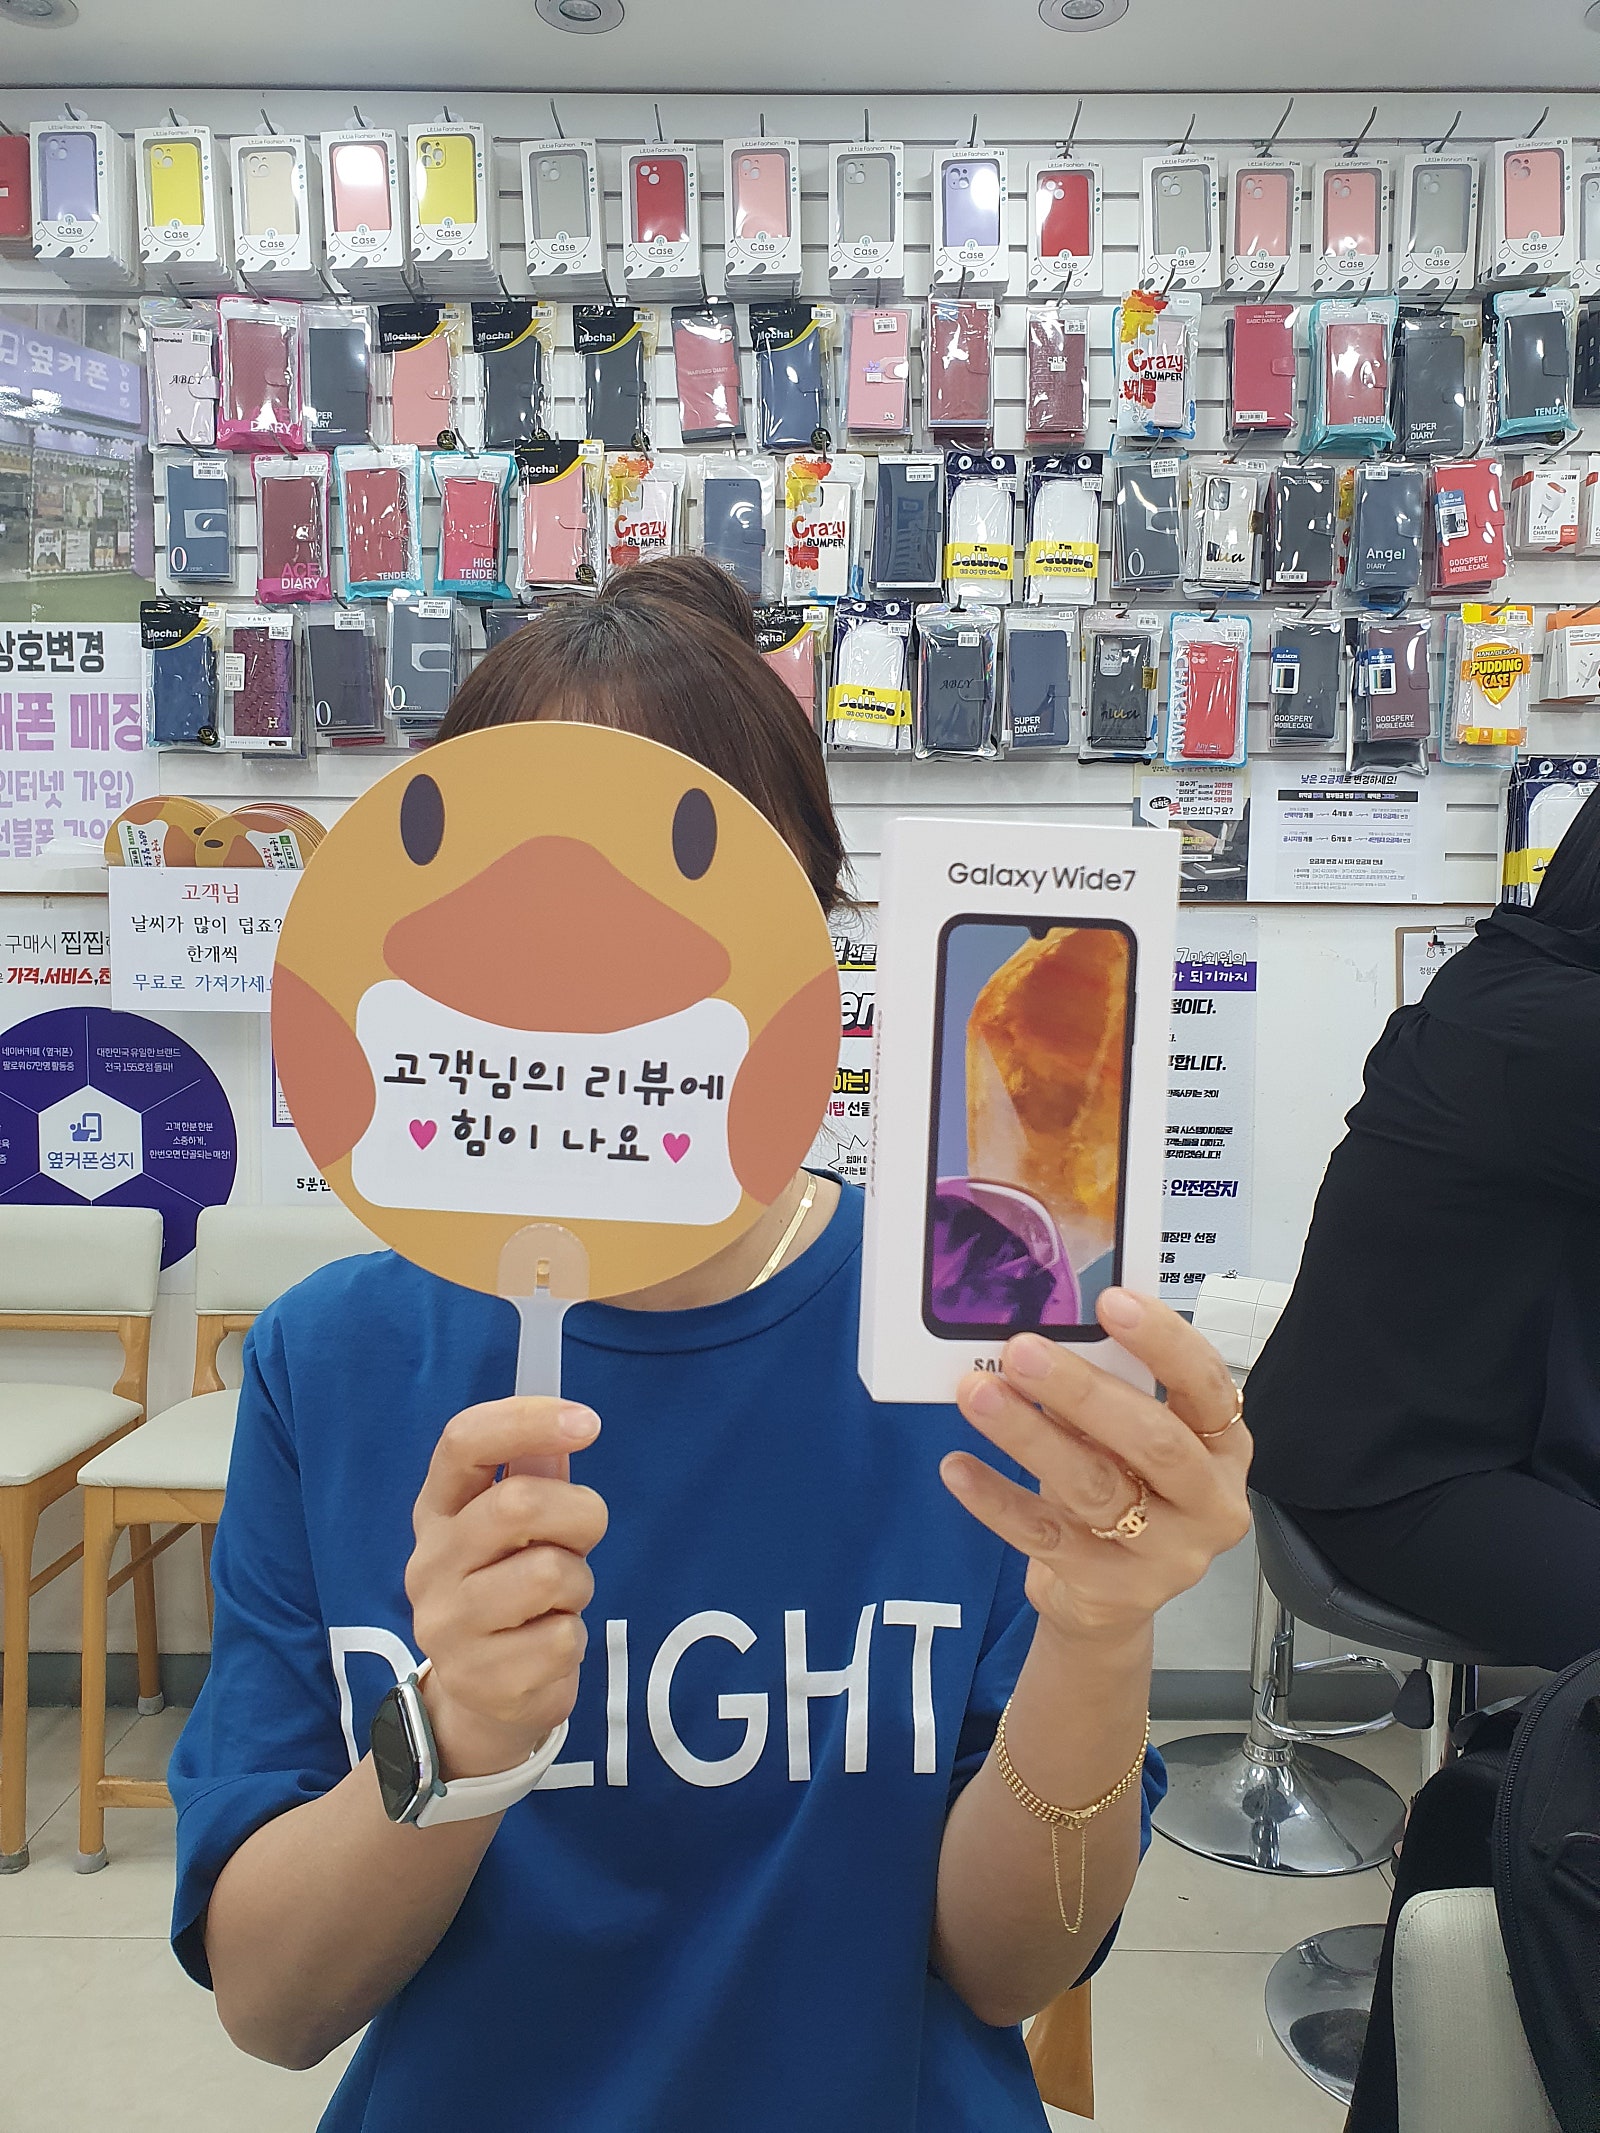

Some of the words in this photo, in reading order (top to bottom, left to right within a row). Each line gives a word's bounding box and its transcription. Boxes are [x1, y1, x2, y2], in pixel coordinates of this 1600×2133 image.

[57, 225, 82, 235] Case
[164, 230, 189, 239] Case
[436, 228, 461, 238] Case
[259, 239, 284, 249] Case
[351, 235, 376, 245] Case
[550, 242, 576, 252] Case
[648, 246, 673, 255] Case
[750, 242, 775, 251] Case
[853, 247, 878, 256] Case
[1522, 243, 1547, 251] Case
[959, 251, 984, 260] Case
[1053, 260, 1078, 270] Case
[1170, 259, 1195, 267] Case
[1250, 260, 1274, 269] Case
[1339, 260, 1364, 269] Case
[1425, 258, 1450, 266] Case
[477, 330, 514, 342] Mocha!
[579, 332, 616, 343] Mocha!
[27, 341, 110, 391] 옆커폰
[1128, 349, 1184, 372] Crazy
[1144, 370, 1182, 381] BUMPER
[1353, 416, 1386, 424] TENDER
[1411, 423, 1437, 431] SUPER
[1411, 431, 1434, 440] DIARY
[615, 515, 667, 539] Crazy
[791, 516, 846, 539] Crazy
[627, 537, 666, 547] BUMPER
[806, 537, 846, 548] BUMPER
[1035, 549, 1094, 568] Jelling
[1366, 548, 1406, 562] Angel
[1449, 555, 1488, 566] GOOSPERY
[473, 558, 498, 568] HIGH
[952, 552, 1008, 570] Jelling
[281, 563, 319, 577] ACE
[460, 568, 498, 578] TENDER
[281, 577, 321, 589] DIARY
[1472, 659, 1523, 674] PUDDING
[940, 679, 975, 690] ABLY
[1482, 673, 1510, 688] CASE
[839, 693, 896, 716] Jelling
[1014, 716, 1040, 725] SUPER
[1375, 714, 1414, 722] GOOSPERY
[1014, 724, 1038, 734] DIARY
[1375, 721, 1415, 730] MOBILECASE
[1300, 774, 1318, 785] 낮은
[1354, 774, 1398, 785] 변경하세요!
[947, 862, 1049, 894] Galaxy
[1052, 864, 1136, 893] Wide7
[181, 883, 240, 904] 고객님
[131, 915, 184, 934] 날씨가
[194, 916, 227, 935] 많이
[238, 916, 283, 935] 덥죠?
[5, 934, 56, 954] 구매시
[187, 945, 238, 964] 한개씩
[1190, 970, 1248, 984] 되기까지
[132, 974, 186, 992] 무료로
[97, 1048, 129, 1057] 대한민국
[156, 1048, 181, 1058] 브랜드
[104, 1062, 122, 1072] 전국
[383, 1049, 565, 1100] 고객님의
[585, 1060, 724, 1107] 리뷰에
[165, 1122, 180, 1132] 고객
[451, 1108, 538, 1157] 힘이
[562, 1124, 650, 1162] 나요
[47, 1152, 134, 1170] 옆커폰성지
[1170, 1179, 1239, 1198] 안전장치
[1194, 1232, 1216, 1244] 선정
[1183, 1273, 1207, 1284] 생략
[329, 1600, 961, 1791] DIGHT
